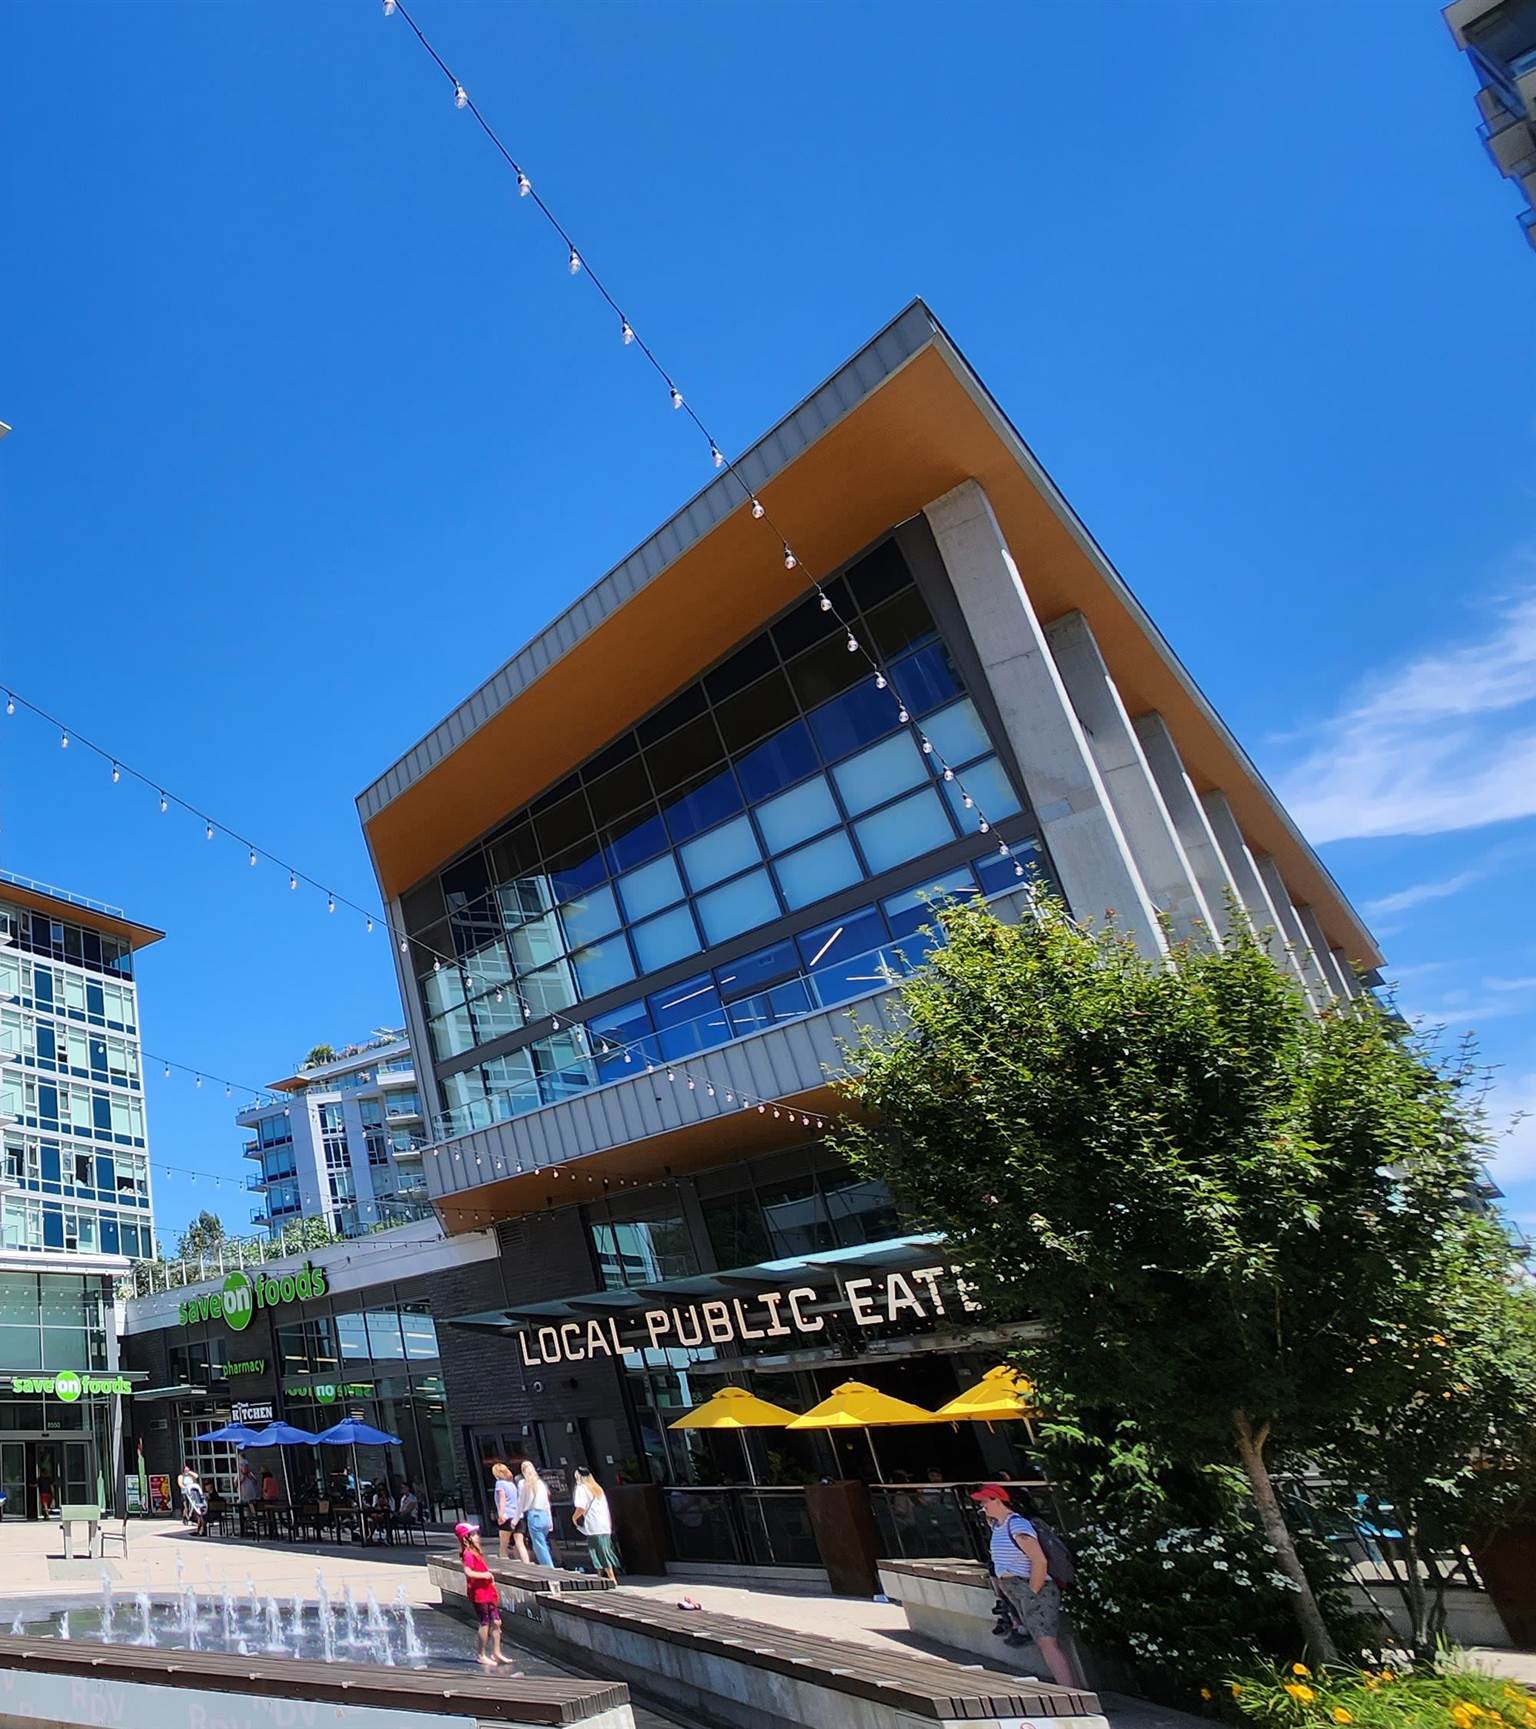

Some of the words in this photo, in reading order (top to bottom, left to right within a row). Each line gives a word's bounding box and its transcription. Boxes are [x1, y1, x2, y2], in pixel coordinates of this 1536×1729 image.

[178, 1296, 223, 1326] save
[224, 1286, 250, 1314] on
[255, 1260, 326, 1309] foods
[518, 1317, 635, 1366] LOCAL
[646, 1288, 824, 1349] PUBLIC
[12, 1376, 55, 1393] save
[57, 1379, 80, 1393] on
[81, 1375, 132, 1394] foods
[223, 1359, 265, 1377] pharmacy
